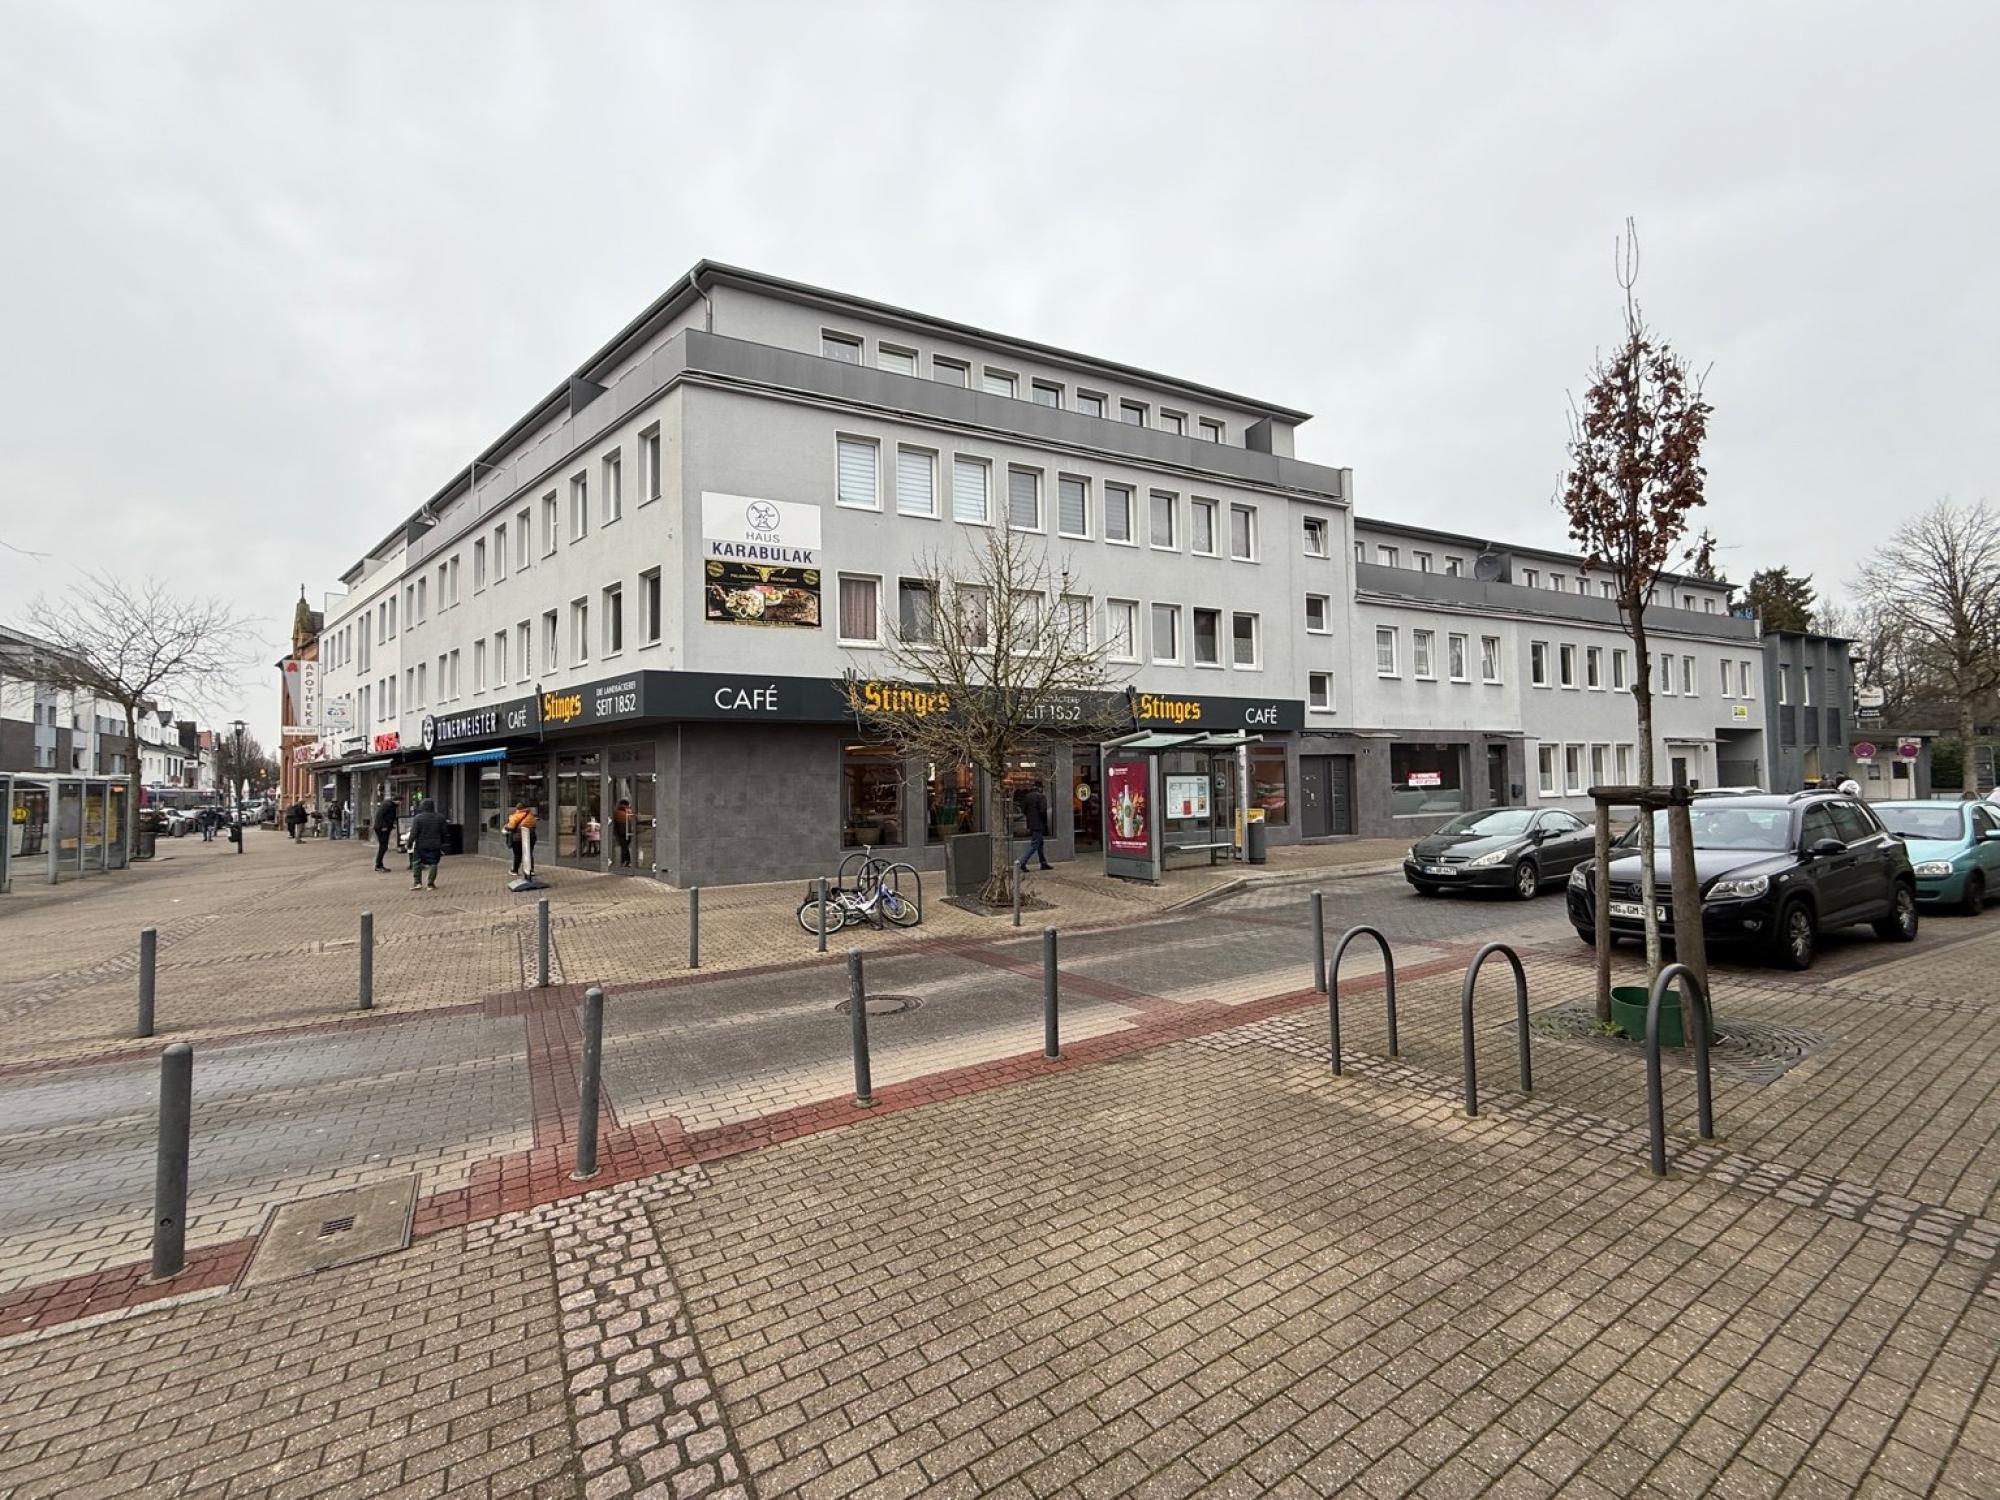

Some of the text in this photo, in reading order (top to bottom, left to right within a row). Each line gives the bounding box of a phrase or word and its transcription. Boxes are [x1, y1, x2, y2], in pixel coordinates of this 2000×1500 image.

[746, 531, 780, 543] HAUS
[712, 542, 812, 563] KARABULAK
[305, 663, 314, 726] APOTHEKE
[543, 692, 582, 723] Stinges
[595, 693, 636, 717] SEIT 1852
[714, 684, 778, 711] CAFÉ
[863, 681, 950, 718] Stinges
[507, 704, 527, 729] CAFÉ
[1140, 694, 1200, 724] Stinges
[1245, 705, 1278, 724] CAFÉ
[437, 712, 497, 740] DÖNERMEISTER
